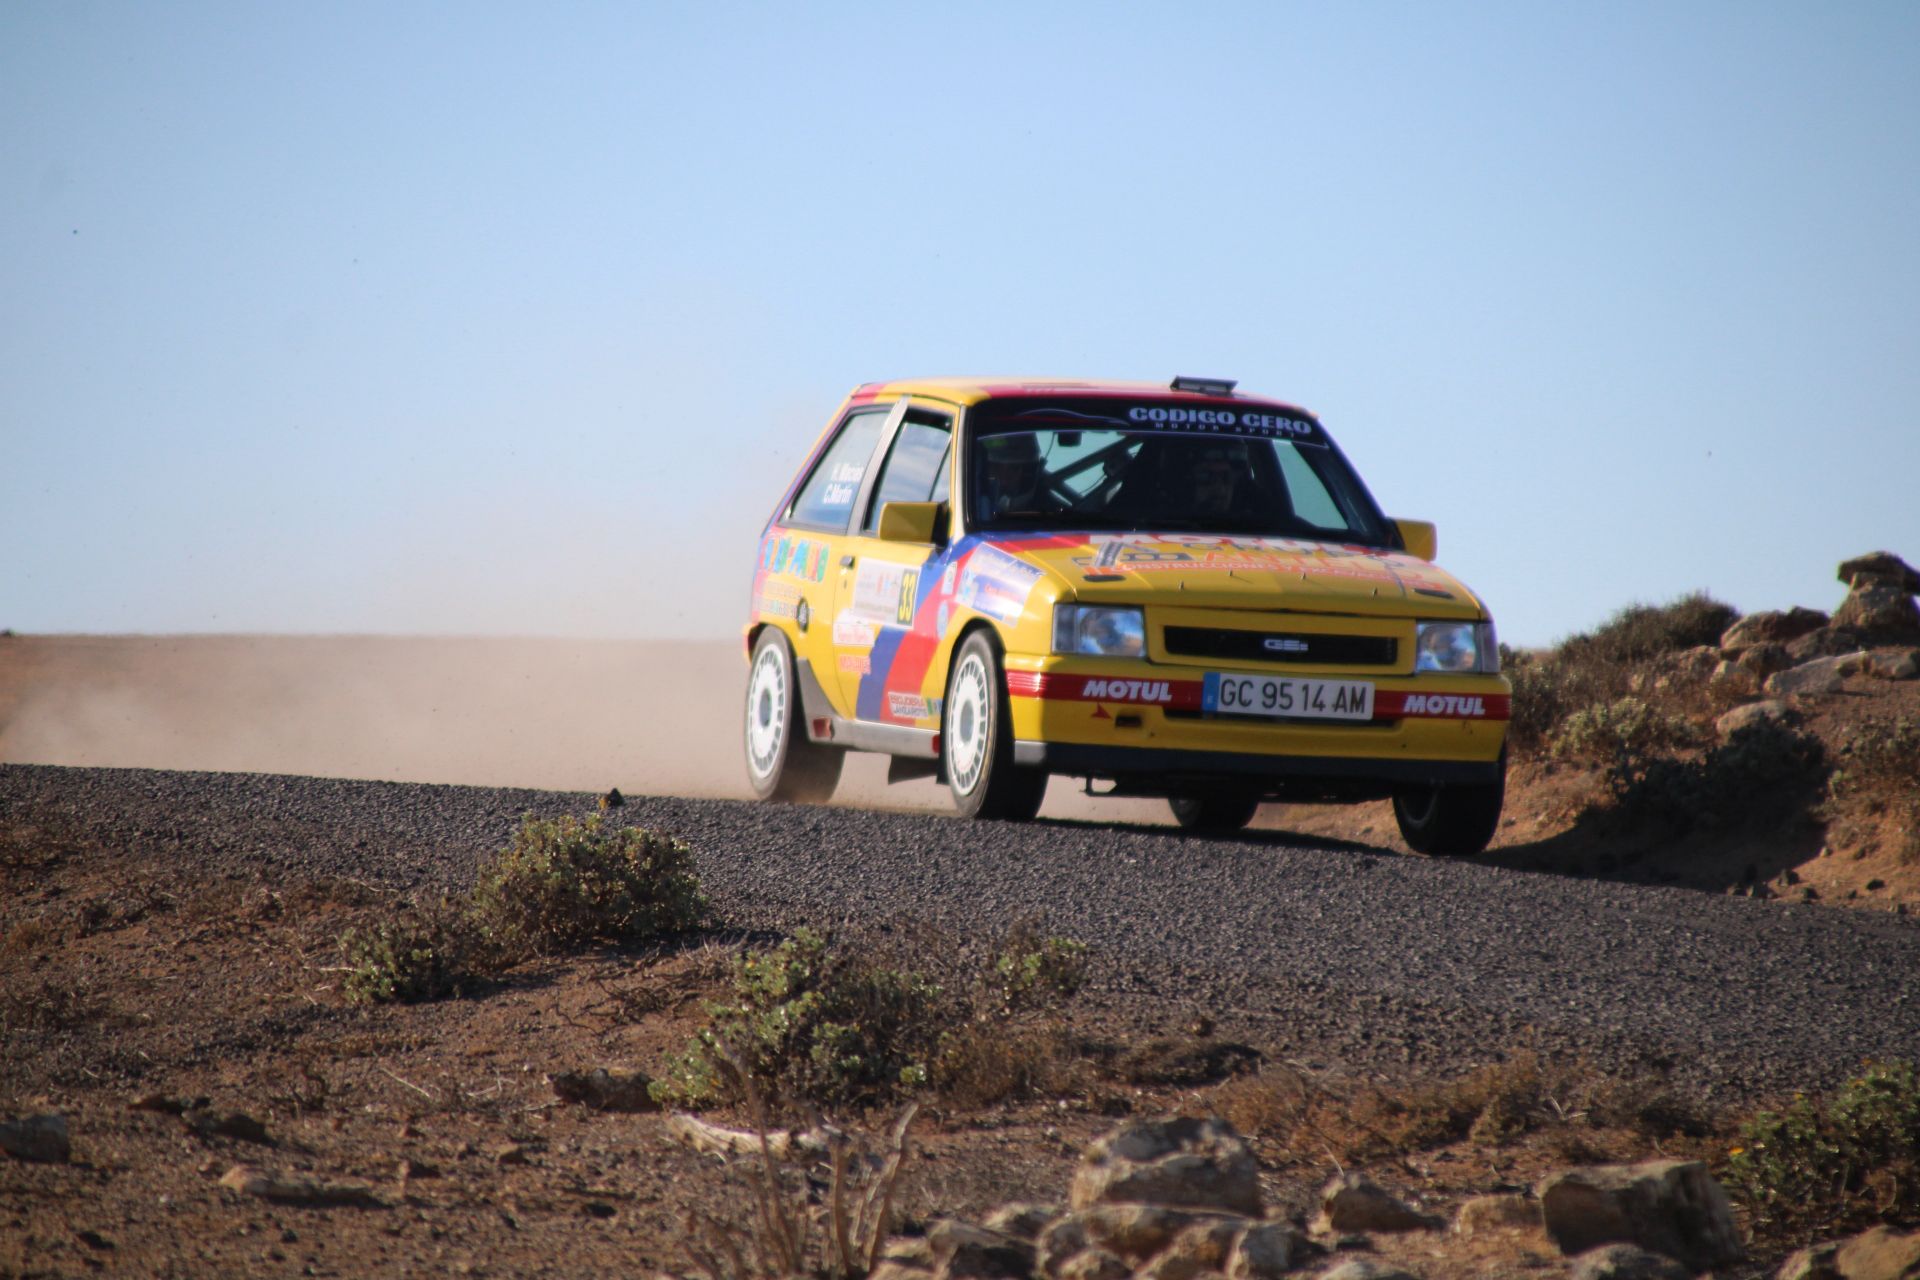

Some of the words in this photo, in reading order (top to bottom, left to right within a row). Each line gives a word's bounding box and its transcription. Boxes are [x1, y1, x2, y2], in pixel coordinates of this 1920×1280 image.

[1129, 407, 1236, 425] CODIGO
[1242, 413, 1312, 434] CERO
[1155, 421, 1220, 432] MOTOR
[898, 572, 918, 623] 33
[1083, 680, 1173, 701] MOTUL
[1220, 679, 1254, 707] GC
[1332, 686, 1366, 713] AM
[1403, 694, 1486, 715] MOTUL
